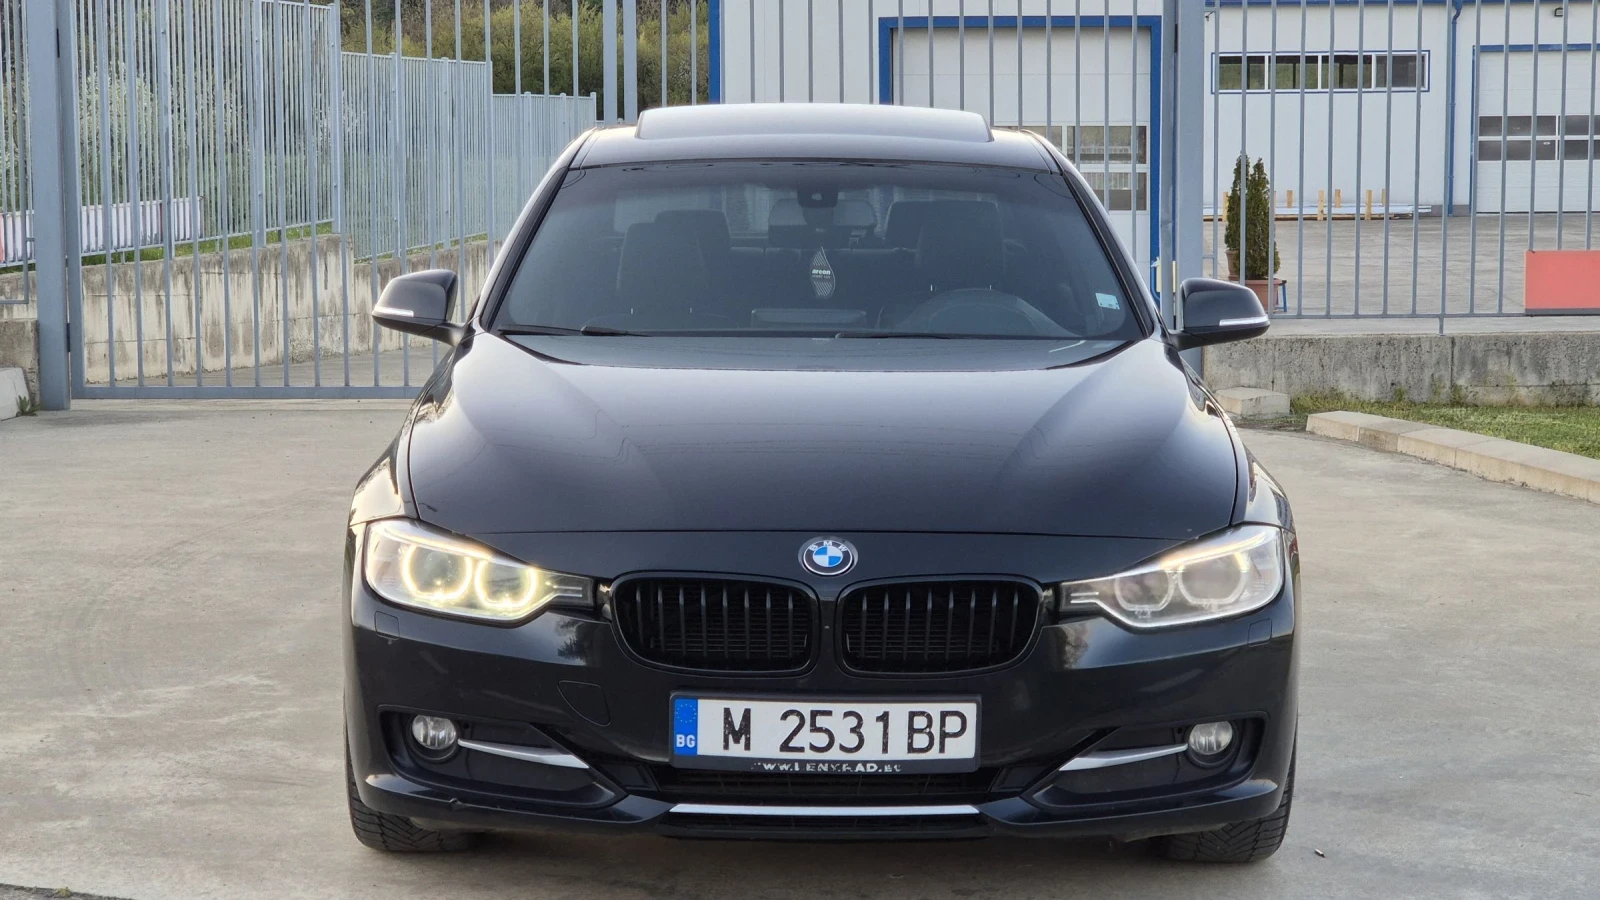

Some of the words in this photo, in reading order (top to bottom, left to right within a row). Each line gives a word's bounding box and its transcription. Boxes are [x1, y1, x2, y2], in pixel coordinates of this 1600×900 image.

[808, 540, 849, 552] BMW
[723, 707, 751, 752] M
[779, 709, 889, 754] 2531
[907, 710, 967, 754] BP
[676, 734, 696, 748] BG
